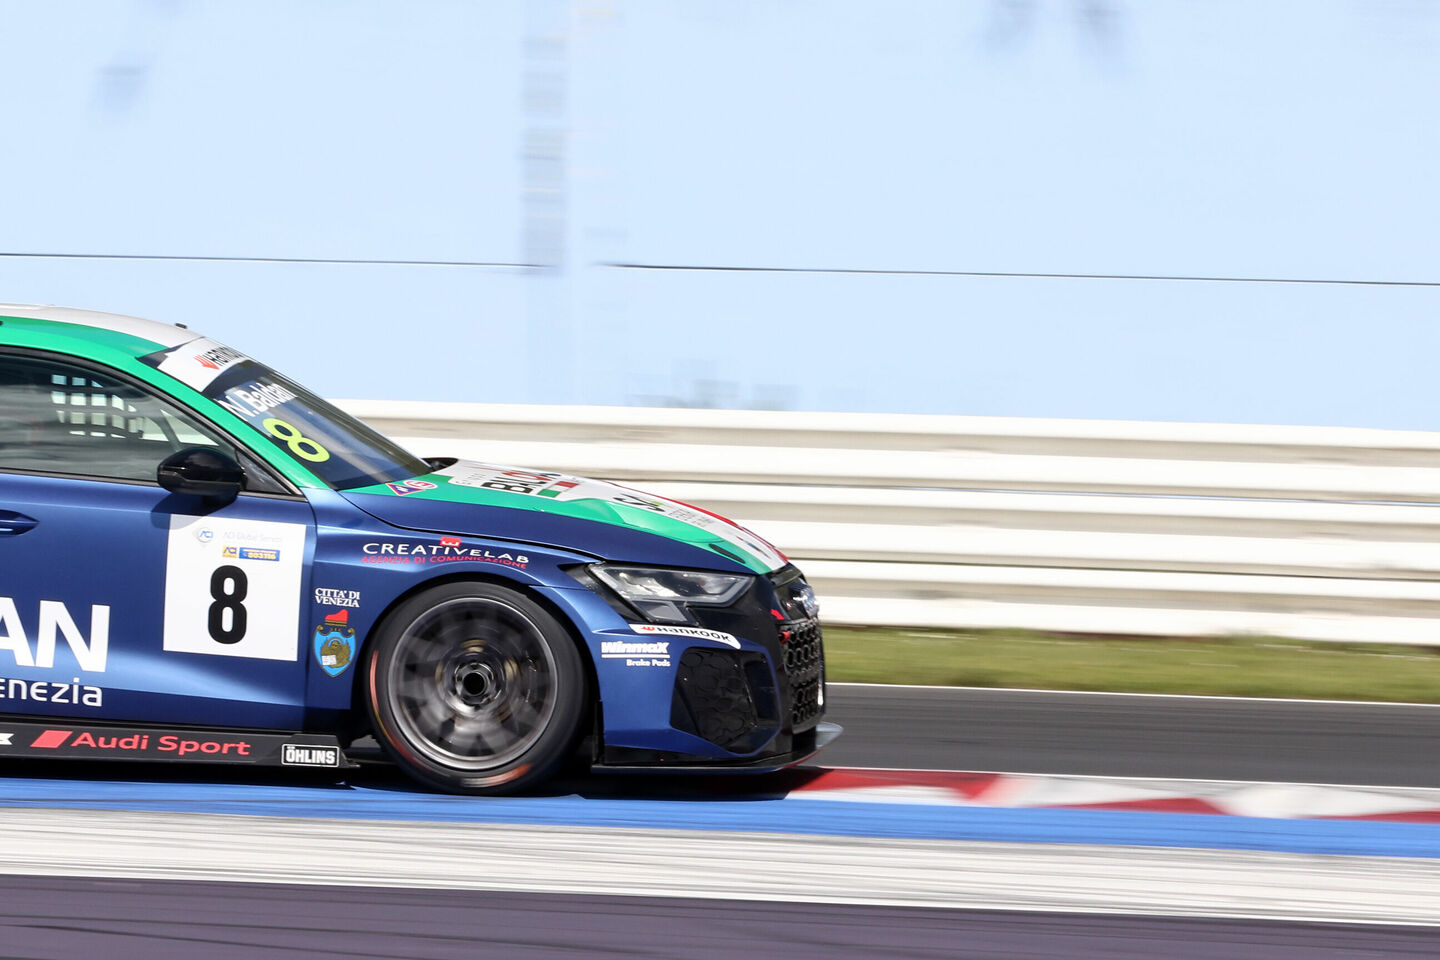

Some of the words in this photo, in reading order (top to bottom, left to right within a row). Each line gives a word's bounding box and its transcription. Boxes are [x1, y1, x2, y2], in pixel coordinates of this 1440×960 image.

[218, 381, 298, 421] N.Baldan
[262, 417, 330, 463] 8
[362, 555, 409, 564] AGENZIA
[414, 556, 426, 564] DI
[429, 555, 527, 569] COMUNICAZIONE
[363, 542, 529, 563] CREATIVELAB
[208, 565, 248, 644] 8
[315, 596, 360, 608] VENEZIA
[349, 591, 360, 600] DI
[626, 659, 650, 667] Brake
[652, 659, 670, 667] Pads
[70, 732, 149, 750] Audi
[157, 735, 251, 756] Sport
[286, 746, 336, 765] ÖHLINS
